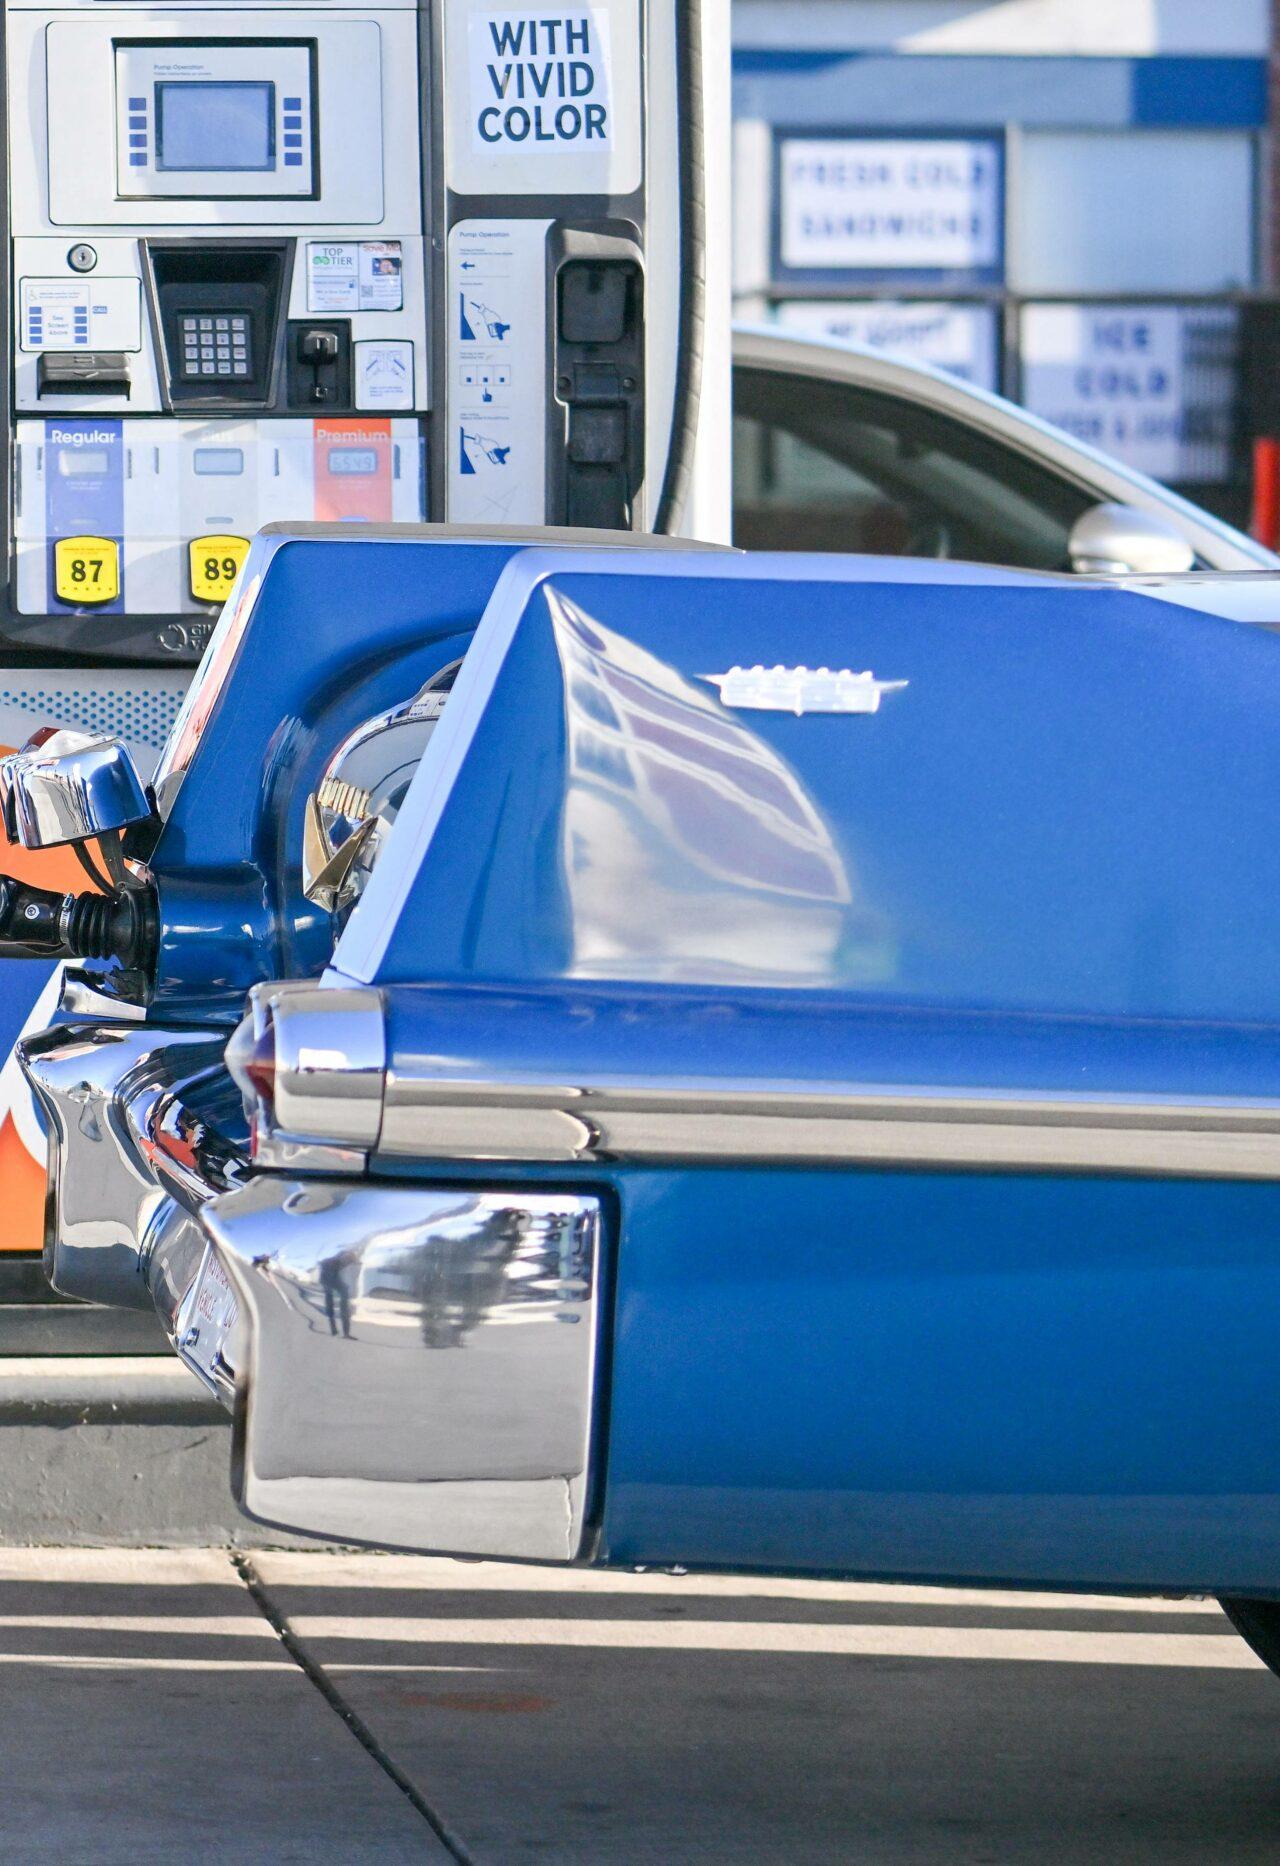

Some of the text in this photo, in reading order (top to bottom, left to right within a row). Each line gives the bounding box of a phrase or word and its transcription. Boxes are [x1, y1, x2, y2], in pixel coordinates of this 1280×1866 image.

[489, 19, 589, 56] WITH
[487, 61, 595, 99] VIVID
[478, 104, 607, 142] COLOR
[322, 247, 343, 257] TOP
[331, 256, 353, 265] TIER
[51, 429, 116, 447] Regular
[317, 429, 388, 444] Premium
[71, 559, 103, 583] 87
[205, 557, 237, 582] 89
